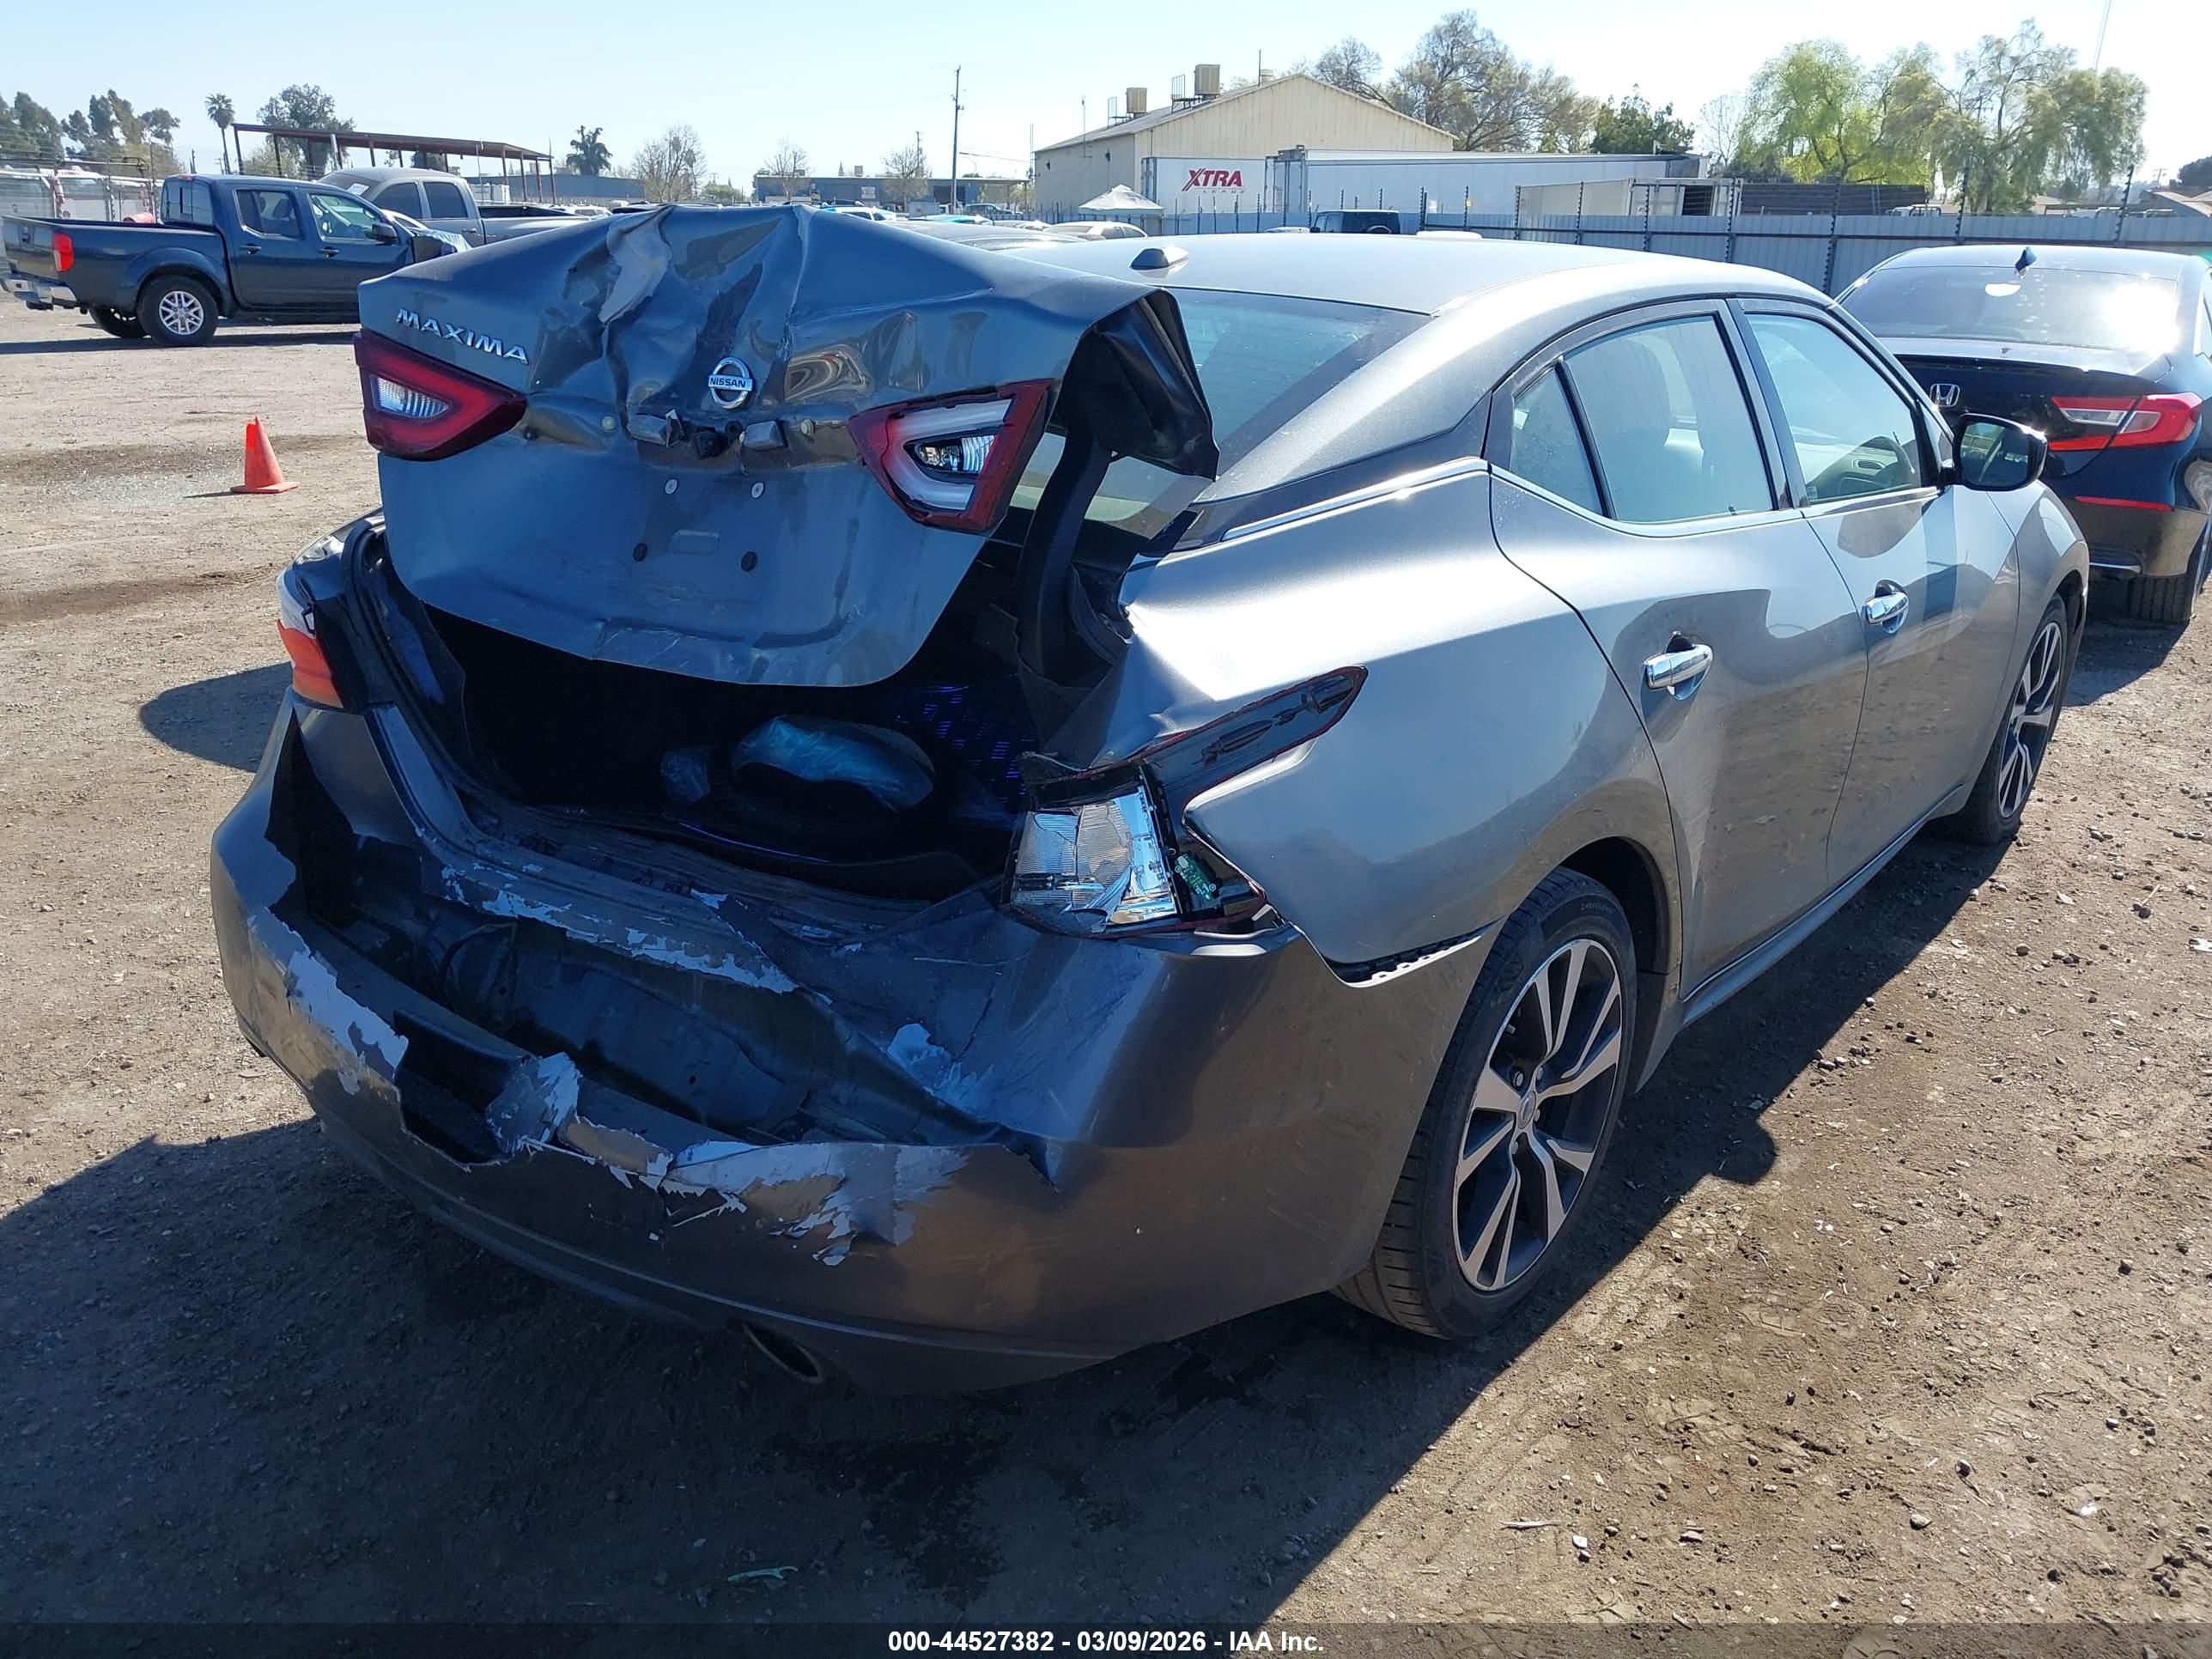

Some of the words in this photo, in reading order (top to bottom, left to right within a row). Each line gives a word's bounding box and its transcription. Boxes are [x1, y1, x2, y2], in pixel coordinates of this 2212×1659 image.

[1182, 167, 1243, 191] XTRA
[396, 308, 529, 365] MAXIMA
[709, 378, 746, 388] NISSAN
